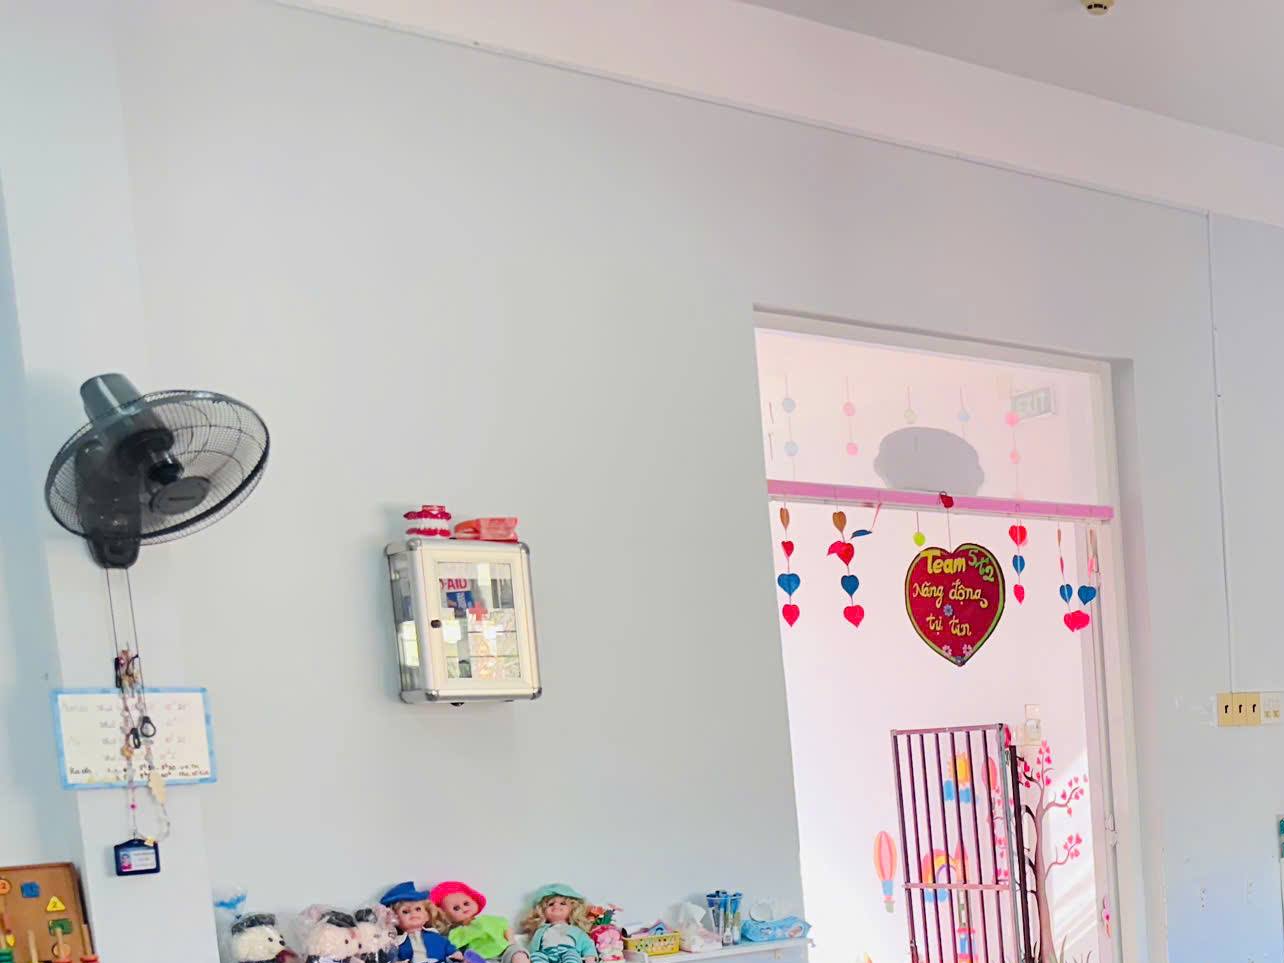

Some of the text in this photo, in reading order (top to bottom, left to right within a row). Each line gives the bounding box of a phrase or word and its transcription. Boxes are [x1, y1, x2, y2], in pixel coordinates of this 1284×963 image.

[920, 550, 966, 574] Team
[912, 578, 988, 608] Năng động
[949, 615, 972, 636] tin
